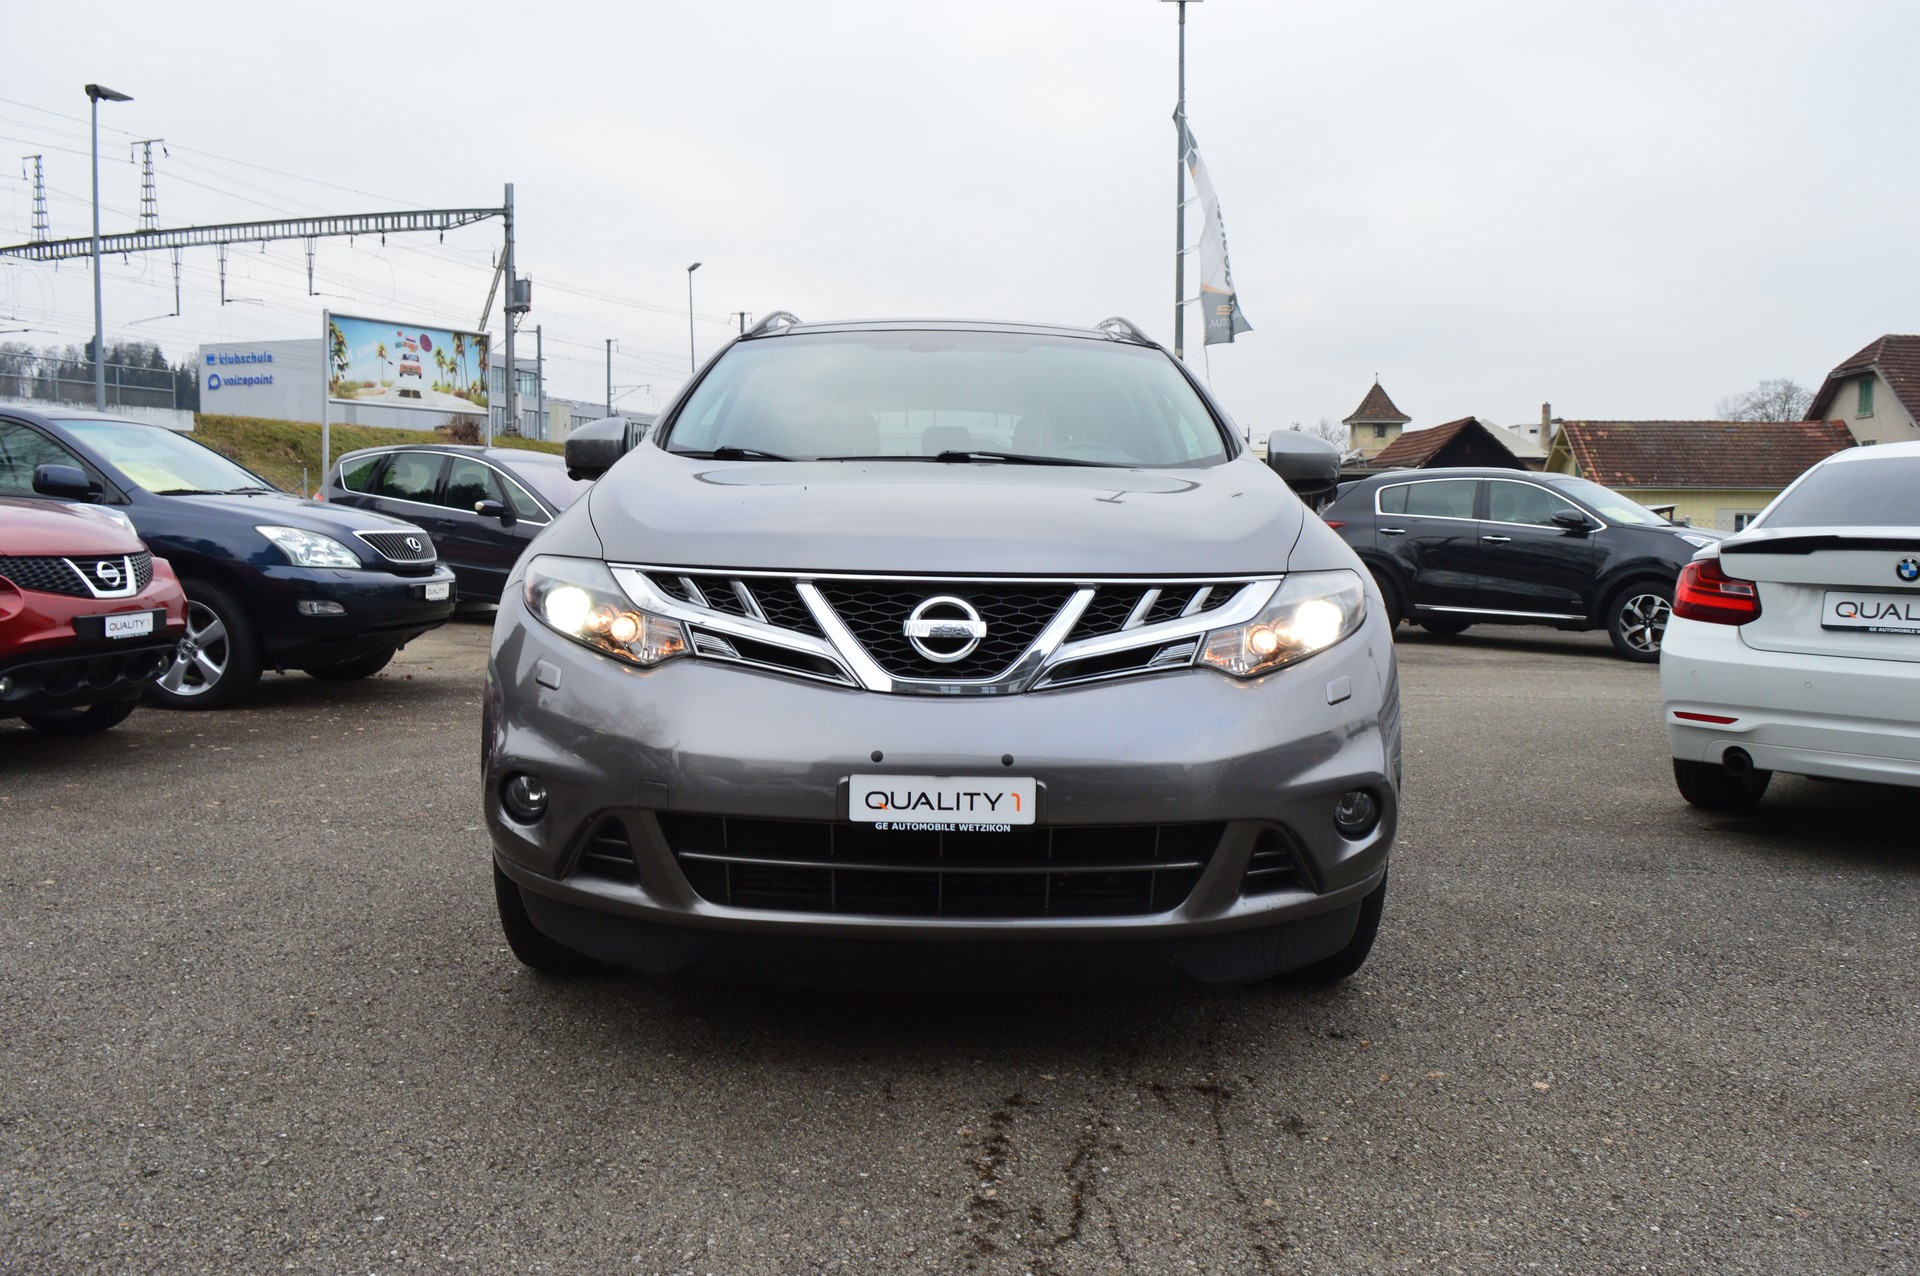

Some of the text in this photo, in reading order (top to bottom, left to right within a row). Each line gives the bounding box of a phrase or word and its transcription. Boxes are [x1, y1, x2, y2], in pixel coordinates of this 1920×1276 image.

[356, 338, 378, 357] und
[219, 351, 273, 365] klubschule
[223, 374, 274, 387] voicepoint
[1835, 601, 1920, 621] QUAL
[109, 619, 145, 632] QUALITY
[910, 622, 979, 636] NISSAN
[865, 790, 1004, 811] QUALITY
[875, 822, 1011, 833] GE AUTOMOBILE WETZIKON
